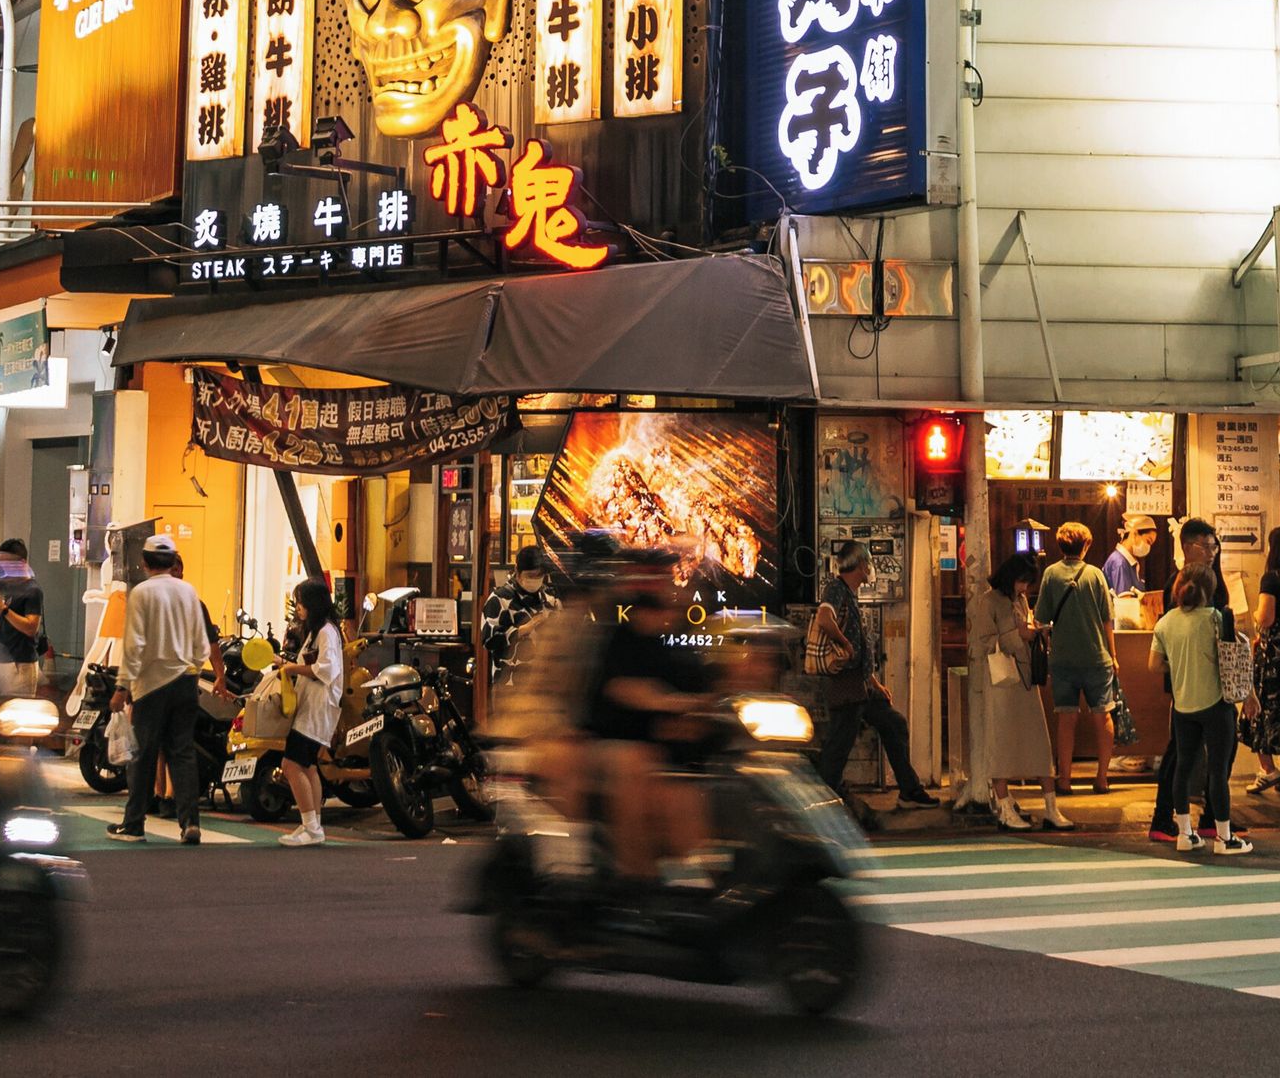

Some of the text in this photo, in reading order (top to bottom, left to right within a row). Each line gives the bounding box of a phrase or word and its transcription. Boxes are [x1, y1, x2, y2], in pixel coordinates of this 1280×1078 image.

[423, 104, 609, 269] 赤鬼
[194, 189, 409, 248] 炙燒牛排
[192, 257, 245, 279] STEAK
[262, 250, 334, 276] ステーキ
